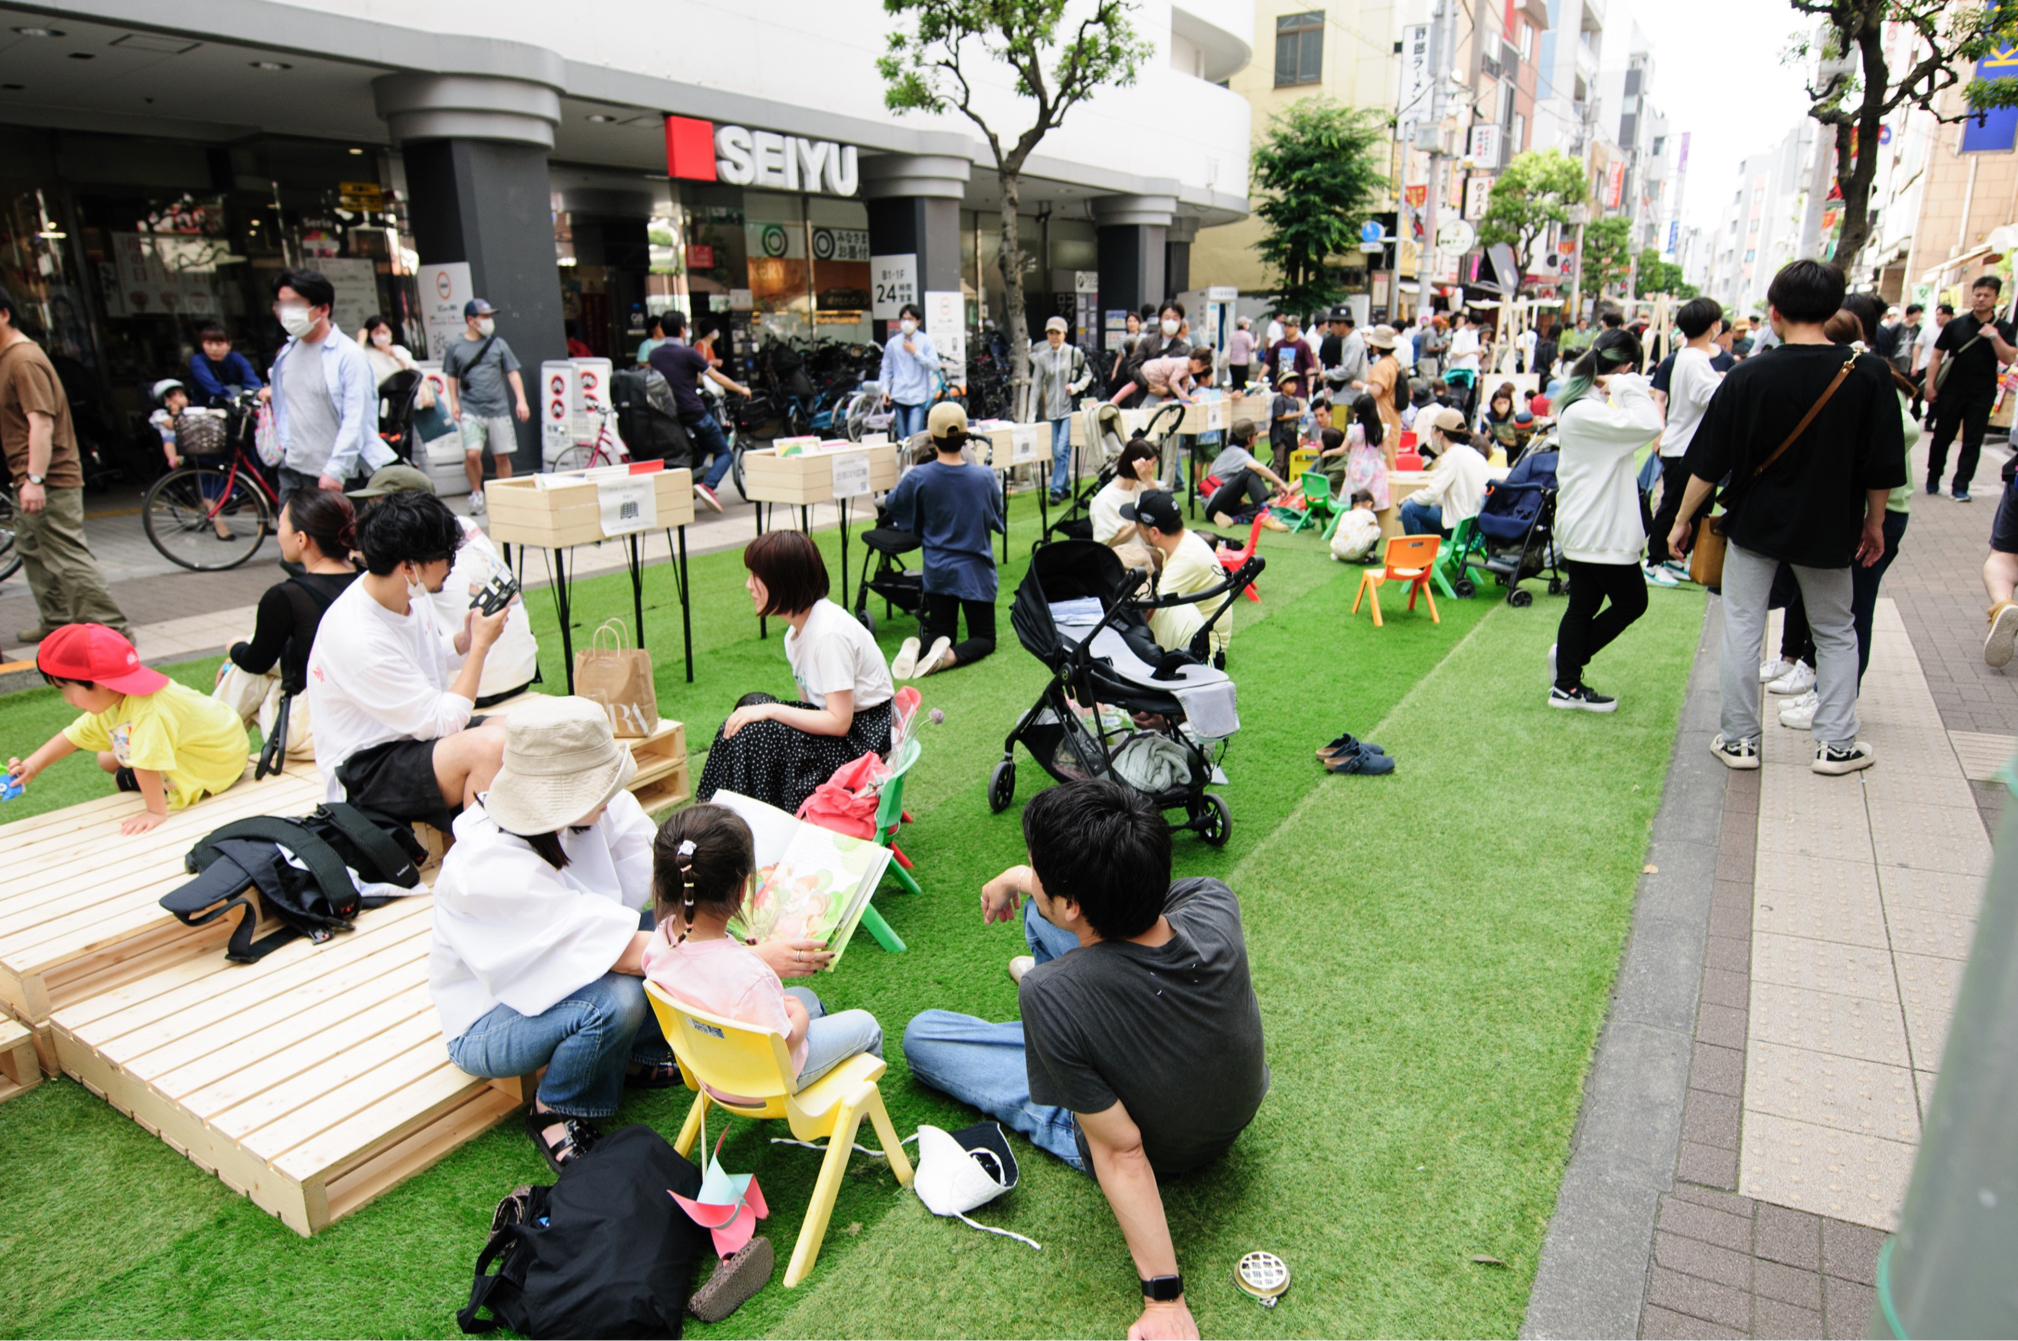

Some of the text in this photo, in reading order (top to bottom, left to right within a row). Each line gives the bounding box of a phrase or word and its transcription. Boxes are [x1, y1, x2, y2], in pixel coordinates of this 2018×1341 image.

[714, 125, 859, 197] SEIYU
[836, 230, 868, 245] みなさま
[876, 283, 897, 304] 24
[607, 702, 650, 736] RA
